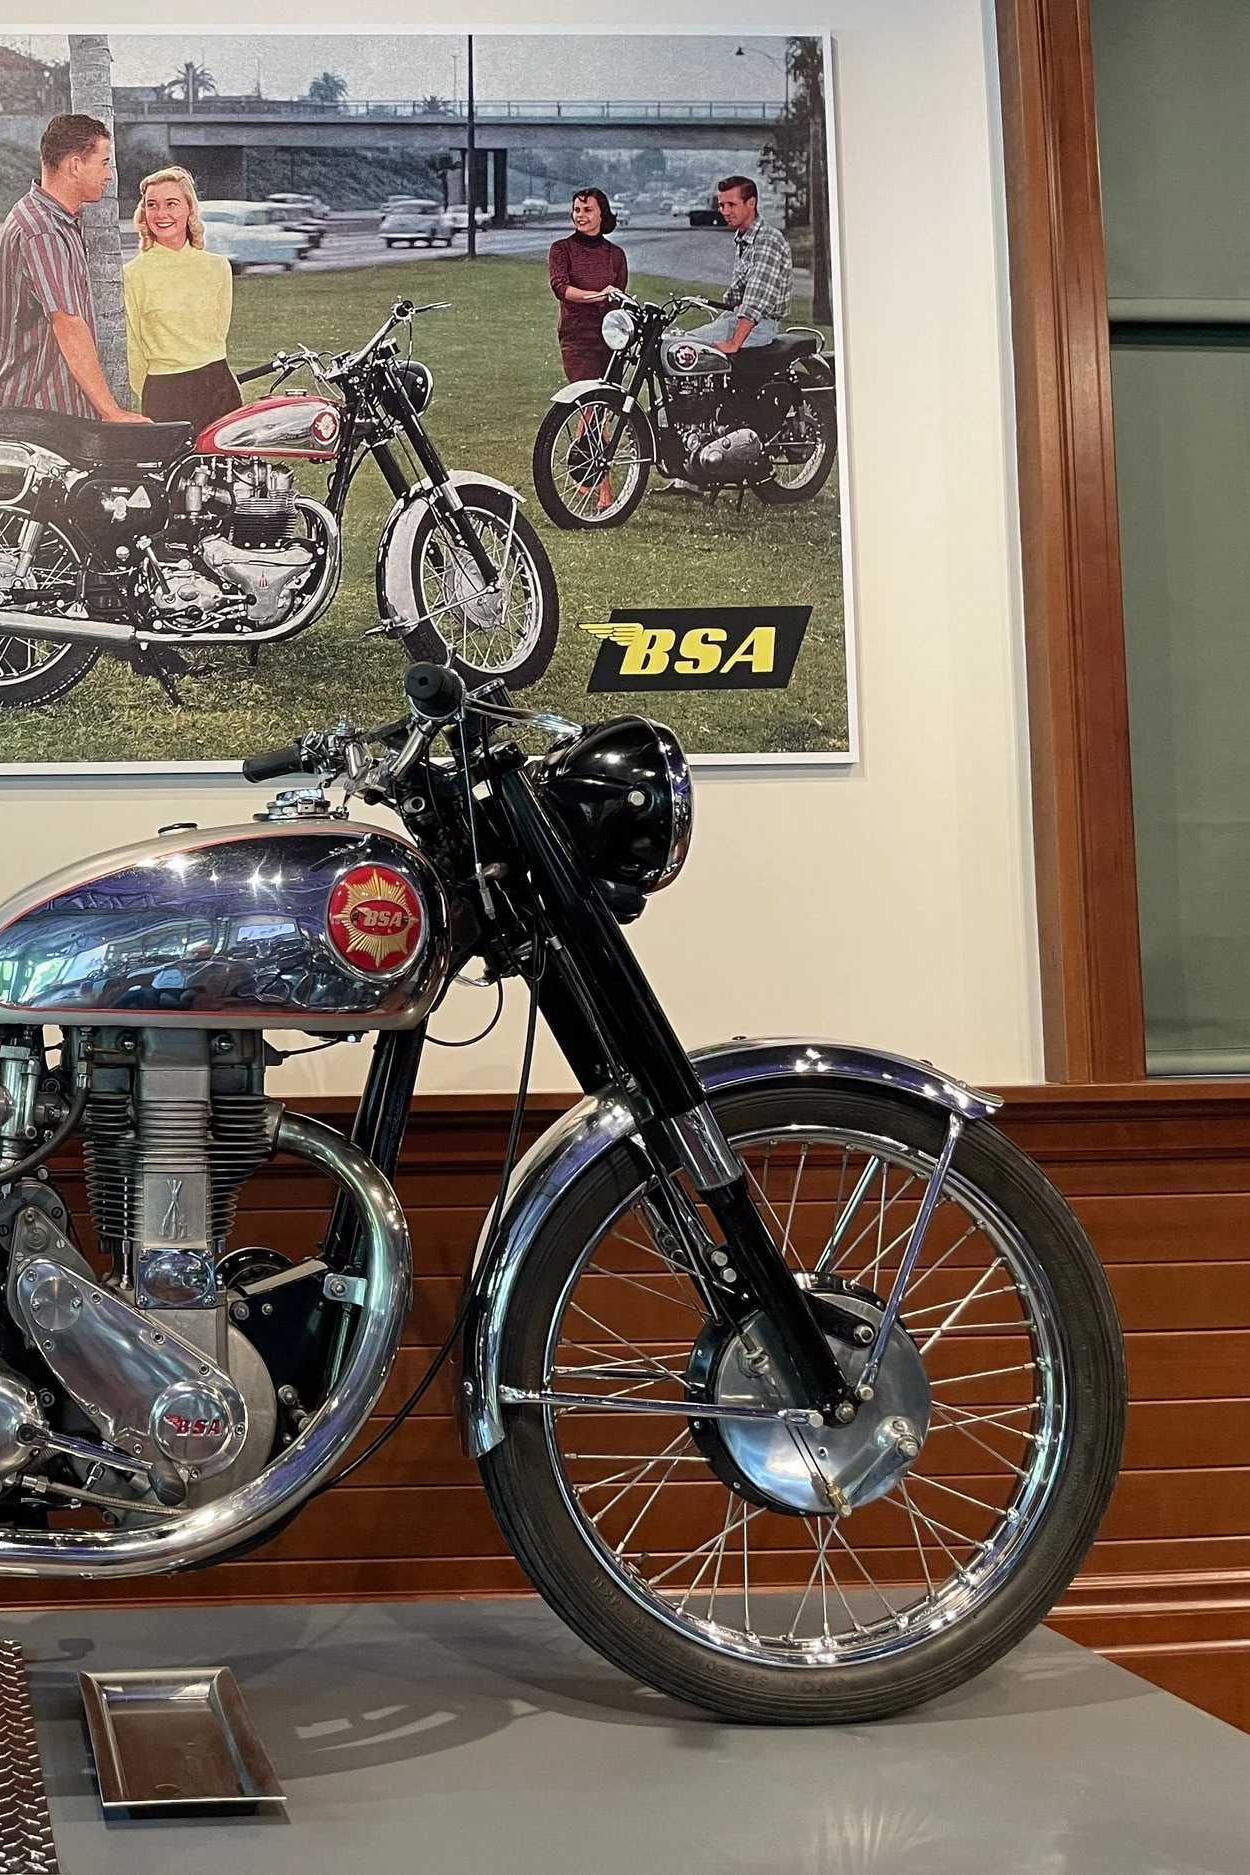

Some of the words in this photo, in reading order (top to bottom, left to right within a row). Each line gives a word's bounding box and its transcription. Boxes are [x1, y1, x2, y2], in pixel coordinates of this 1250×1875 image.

[617, 625, 777, 675] BSA
[362, 909, 403, 927] BSA
[175, 1417, 222, 1437] BSA
